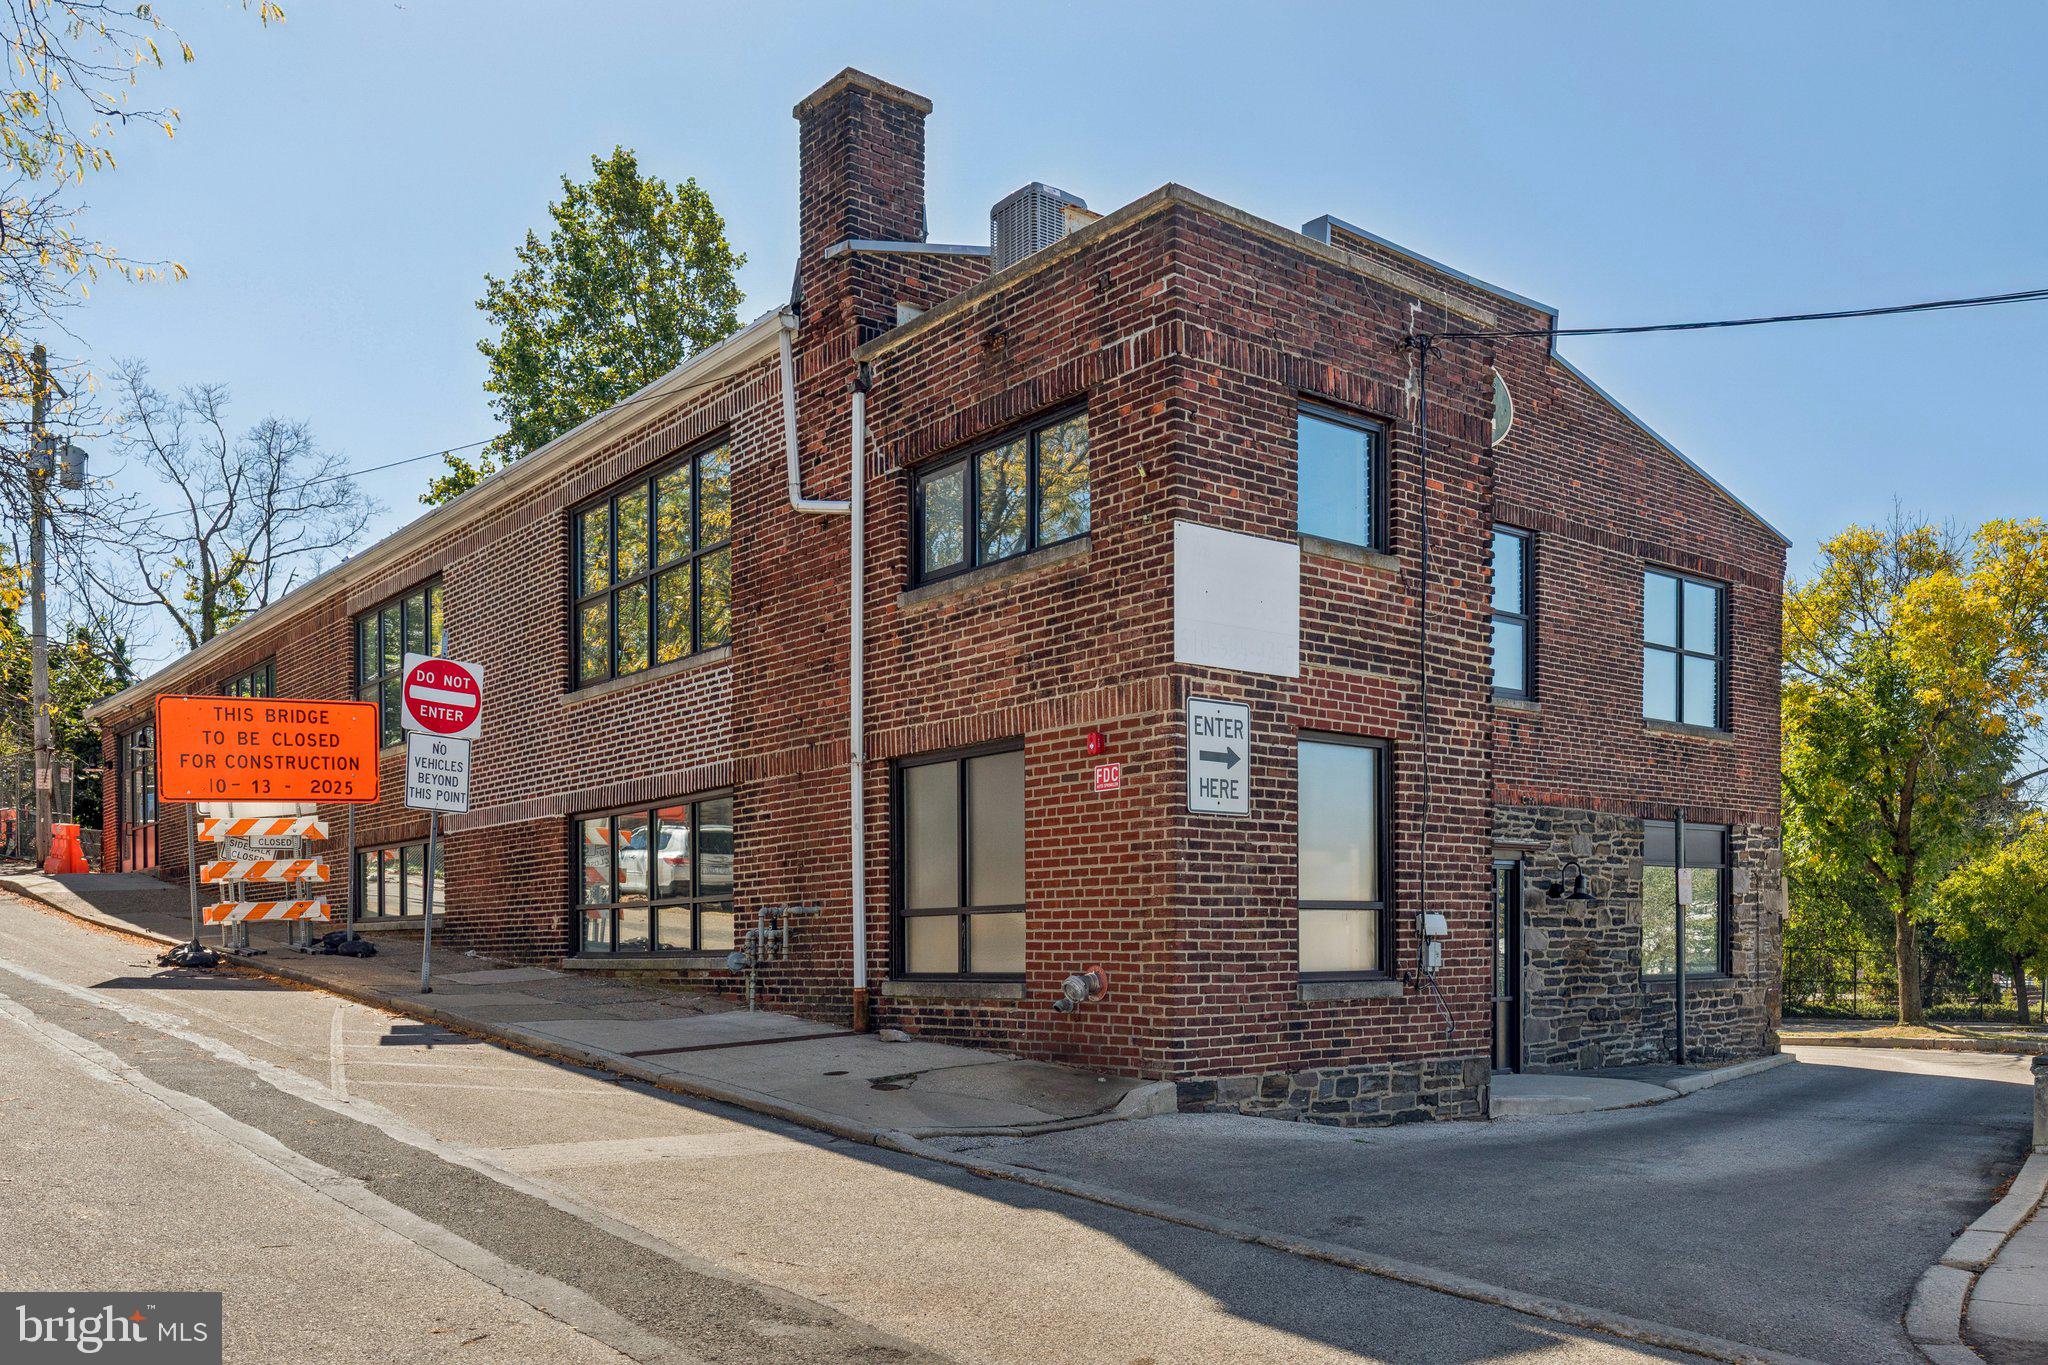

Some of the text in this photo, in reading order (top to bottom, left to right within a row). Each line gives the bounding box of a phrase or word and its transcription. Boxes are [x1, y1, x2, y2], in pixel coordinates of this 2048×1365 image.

[416, 670, 471, 689] DO NOT
[213, 706, 330, 725] THIS BRIDGE
[420, 705, 464, 722] ENTER
[1194, 715, 1244, 740] ENTER
[202, 730, 340, 748] TO BE CLOSED
[432, 743, 447, 756] NO
[180, 753, 360, 771] FOR CONSTRUCTION
[414, 756, 464, 773] VEHICLES
[418, 772, 459, 788] BEYOND
[1096, 766, 1119, 783] FDC
[310, 779, 353, 795] 2025
[409, 786, 466, 804] THIS POINT
[1199, 777, 1240, 800] HERE
[258, 838, 292, 847] CLOSED
